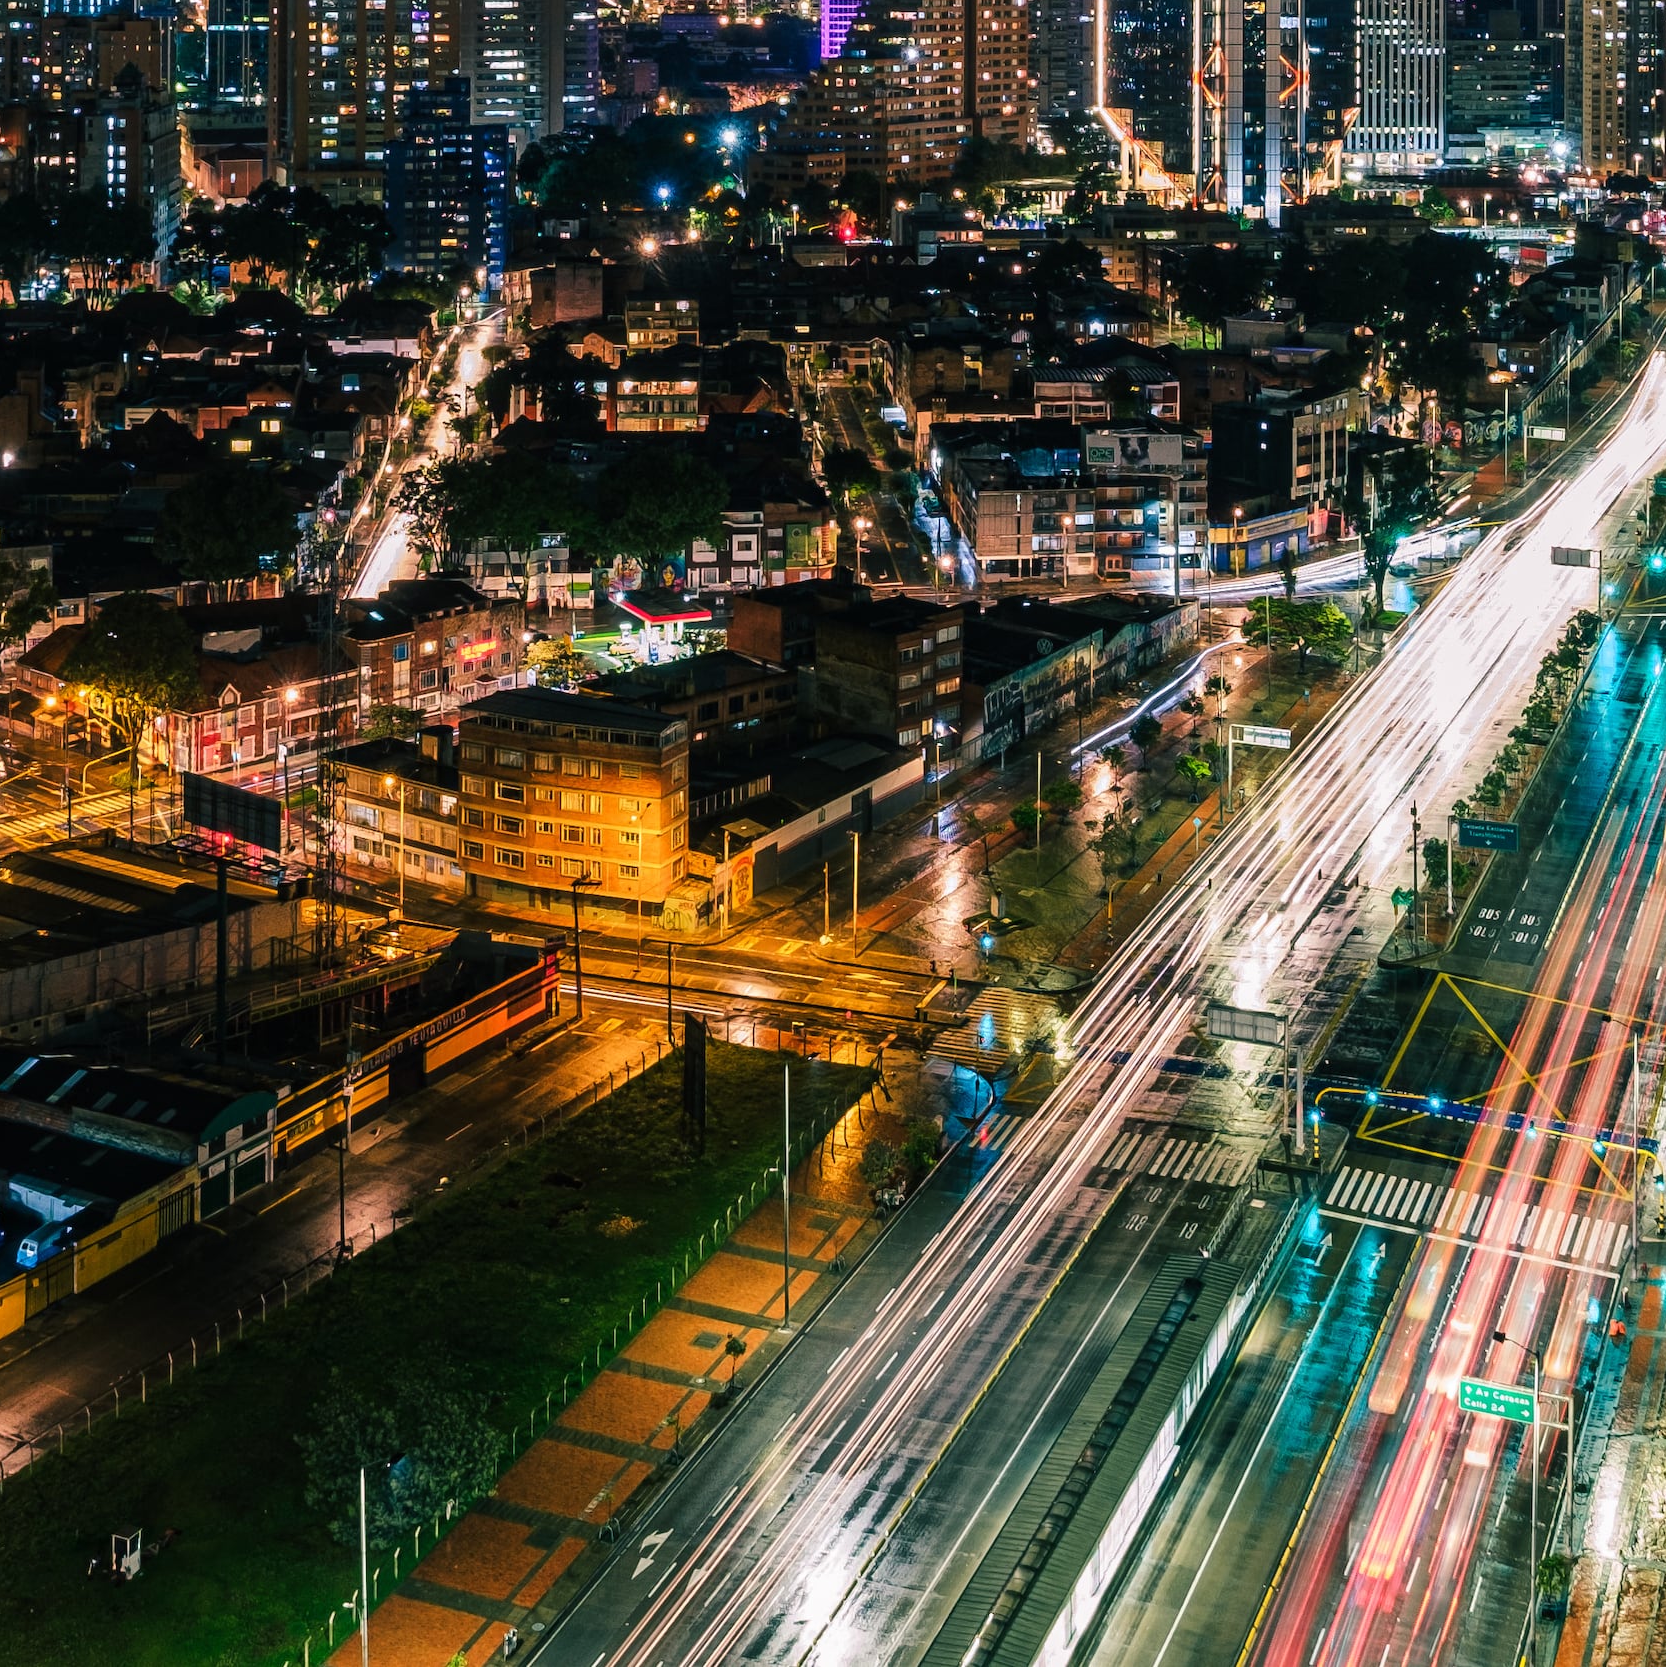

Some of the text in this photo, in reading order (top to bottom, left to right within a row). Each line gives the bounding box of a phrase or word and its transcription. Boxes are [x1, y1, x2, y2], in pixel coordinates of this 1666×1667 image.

[1478, 907, 1502, 921] BUS
[1519, 914, 1542, 927] BUS
[1475, 1387, 1530, 1406] Av Caracas
[1464, 1397, 1506, 1413] Calle 24
